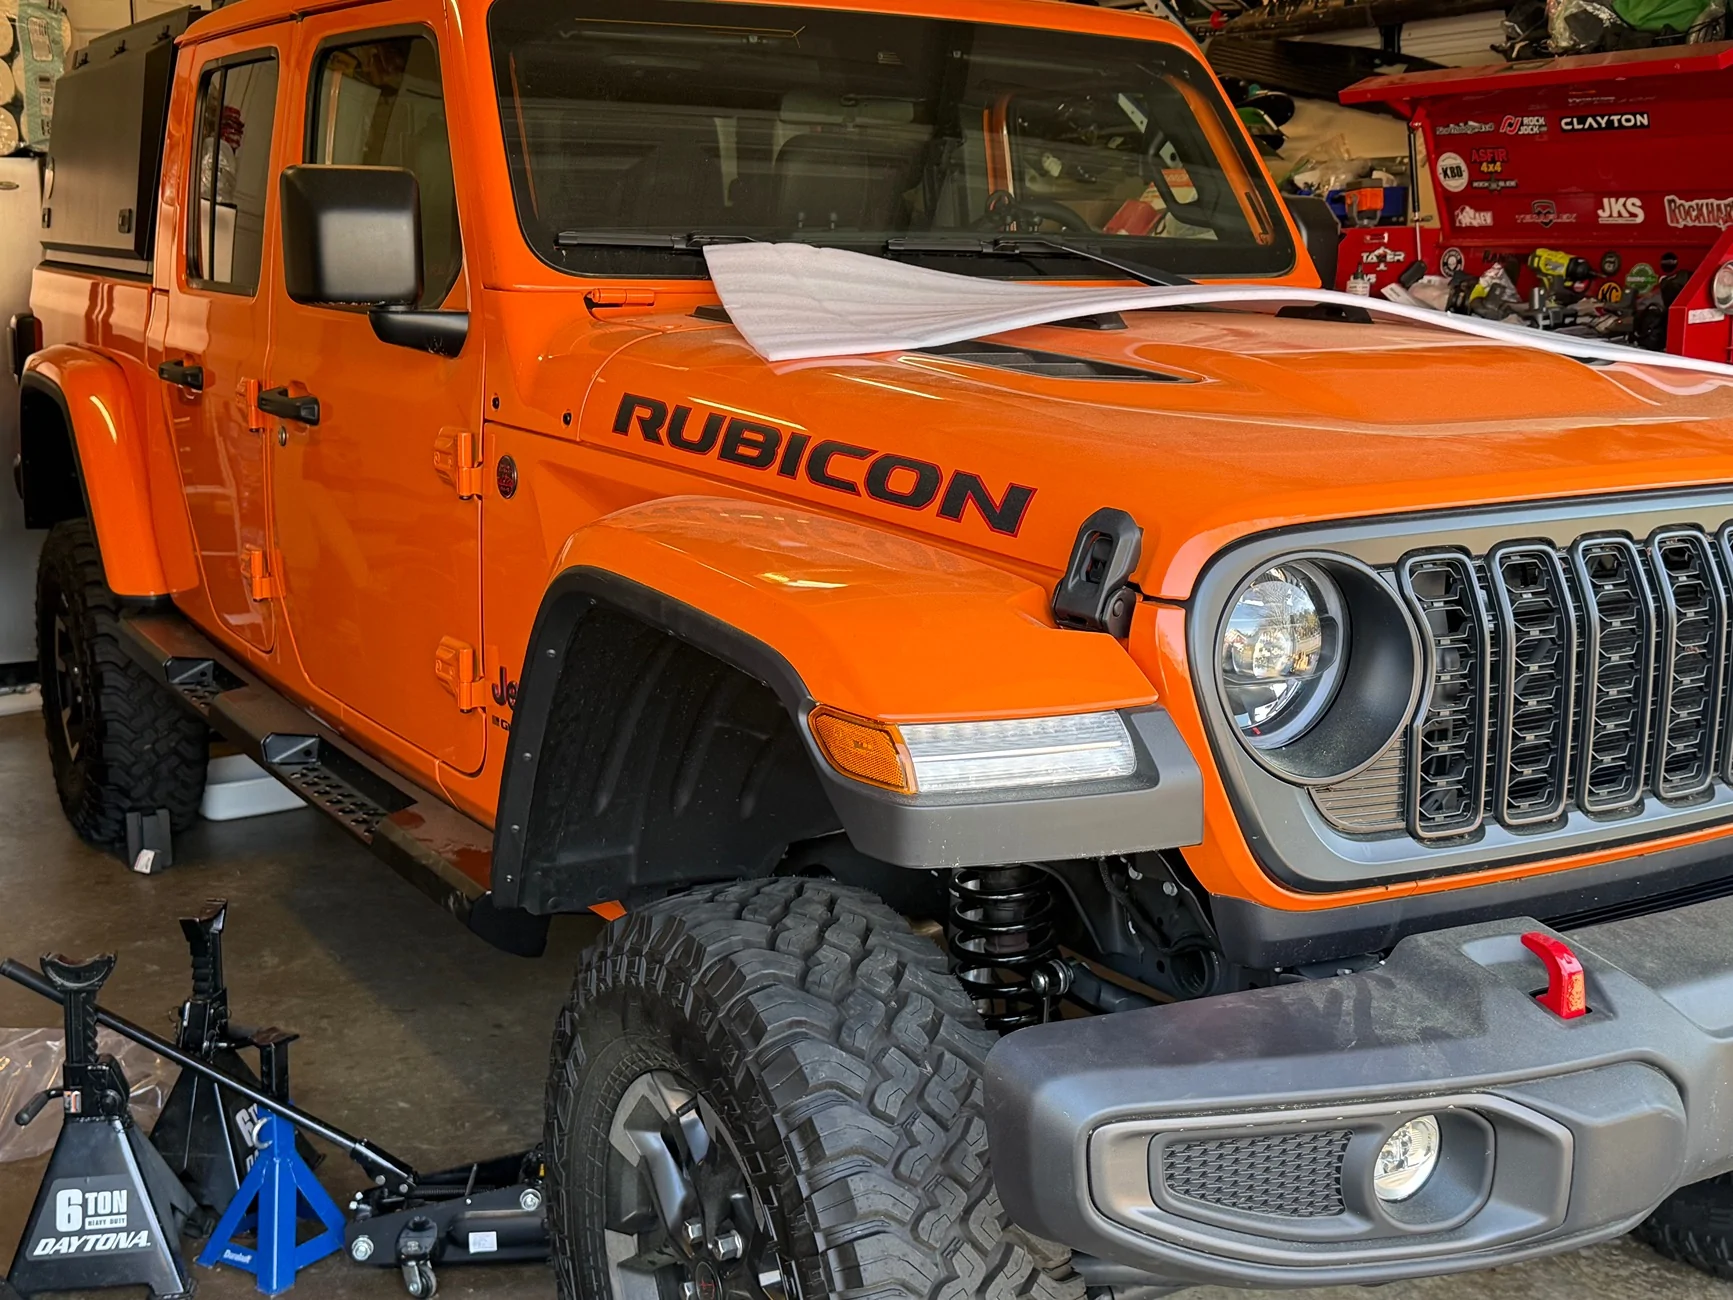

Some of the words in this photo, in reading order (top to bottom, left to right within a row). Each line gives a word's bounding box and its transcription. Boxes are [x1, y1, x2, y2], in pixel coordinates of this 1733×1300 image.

[1518, 126, 1540, 134] JOCK
[1523, 117, 1545, 125] ROCK
[1561, 114, 1648, 130] CLAYTON
[1597, 198, 1645, 223] JKS
[1361, 250, 1405, 263] TAER
[611, 392, 1038, 538] RUBICON
[492, 665, 519, 712] Je
[56, 1188, 83, 1232] 6
[85, 1189, 128, 1216] TON
